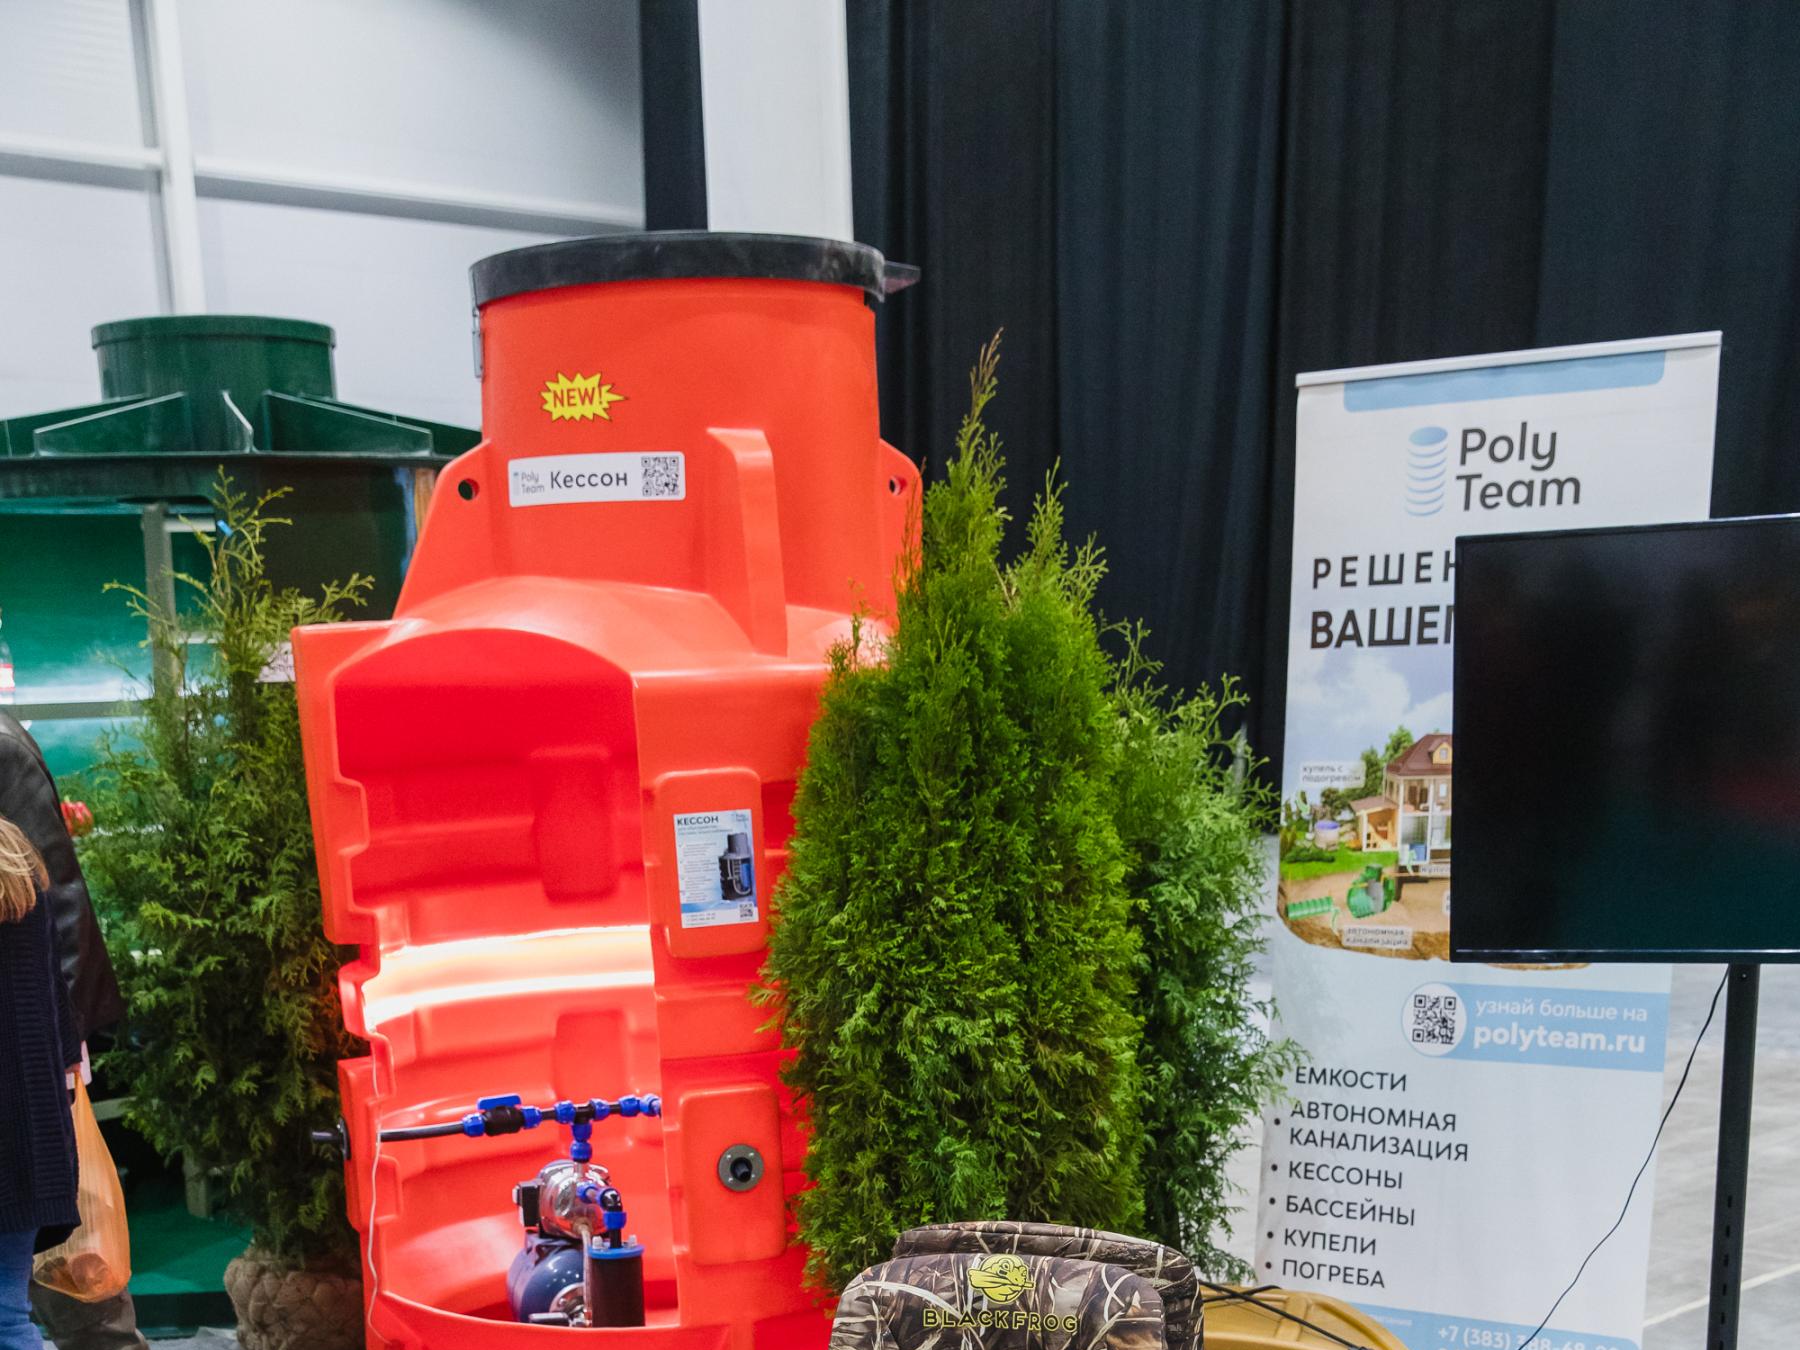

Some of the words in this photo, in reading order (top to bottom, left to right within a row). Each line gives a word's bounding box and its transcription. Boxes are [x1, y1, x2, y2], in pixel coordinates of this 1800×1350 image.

[553, 386, 604, 408] NEW!
[1459, 421, 1558, 472] Poly
[521, 471, 540, 483] Poly
[521, 484, 545, 494] Team
[550, 470, 628, 489] Кессон
[1456, 473, 1581, 511] Team
[677, 815, 719, 826] КЕССОН
[1475, 998, 1534, 1016] узнай
[1540, 999, 1618, 1020] больше
[1623, 1007, 1648, 1022] на
[1473, 1022, 1646, 1053] polyteam.ru
[1295, 1066, 1407, 1092] ЕМКОСТИ
[1290, 1100, 1457, 1132] АВТОНОМНАЯ
[1290, 1127, 1469, 1162] КАНАЛИЗАЦИЯ
[1289, 1161, 1403, 1189] КЕССОНЫ
[1286, 1195, 1415, 1226] БАССЕЙНЫ
[1284, 1228, 1377, 1255] КУПЕЛИ
[1282, 1259, 1385, 1288] ПОГРЕБА
[923, 1309, 1079, 1331] BLACKFROG
[1438, 1325, 1458, 1342] +7
